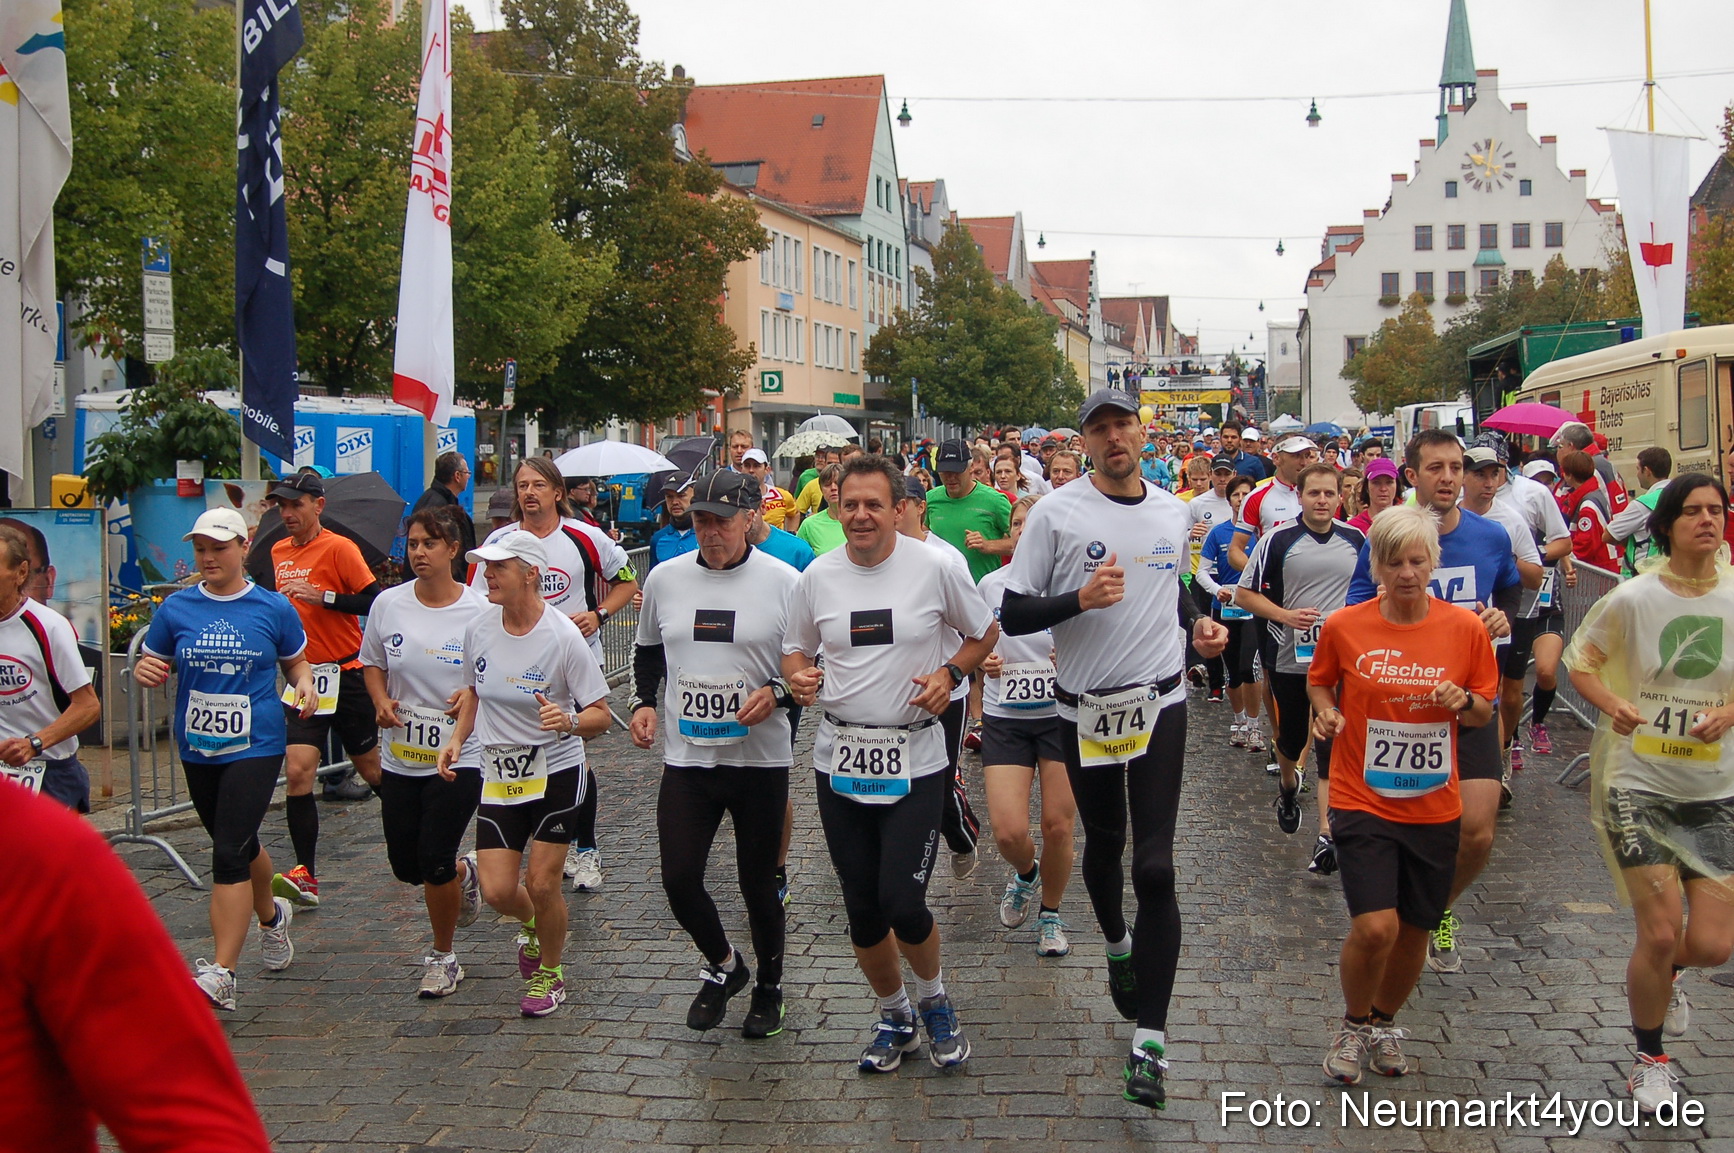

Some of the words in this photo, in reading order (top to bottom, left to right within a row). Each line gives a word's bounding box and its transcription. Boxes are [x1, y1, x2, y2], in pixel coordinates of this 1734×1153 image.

[244, 0, 298, 54] BIL
[764, 374, 779, 389] D
[1169, 393, 1201, 402] START
[1600, 380, 1651, 407] Bayerisches
[1600, 410, 1623, 429] Rotes
[1607, 437, 1623, 452] euz
[1677, 462, 1706, 474] Bayerisches
[278, 567, 312, 579] Fischer
[1542, 577, 1549, 591] 7
[182, 647, 196, 659] 13.
[232, 649, 263, 657] Stadtlauf
[1370, 661, 1445, 678] Fischer
[312, 675, 328, 694] 0
[678, 680, 697, 688] PARTL
[1006, 677, 1057, 700] 2393
[1377, 677, 1440, 686] AUTOMOBILE
[12, 689, 38, 704] Autohaus
[205, 700, 238, 708] Neumarkt
[1080, 701, 1104, 711] PARTL
[1107, 696, 1145, 710] Neumarkt
[1640, 691, 1669, 702] PARTL
[1671, 696, 1713, 707] Neumarkt
[682, 691, 741, 719] 2994
[191, 707, 244, 734] 2250
[396, 707, 413, 718] PARTL
[414, 713, 444, 723] Neumarkt
[1094, 706, 1146, 736] 474
[1654, 706, 1701, 737] 41
[404, 721, 441, 748] 118
[692, 725, 730, 736] Michael
[1369, 727, 1396, 737] PARTL
[403, 750, 437, 762] maryam
[1373, 740, 1443, 769] 2785
[1661, 742, 1693, 756] Liane
[493, 755, 534, 779] 192
[838, 746, 902, 775] 2488
[852, 781, 886, 793] Martin
[1394, 776, 1419, 788] Gabi
[507, 785, 523, 795] Eva
[921, 829, 936, 868] odlo
